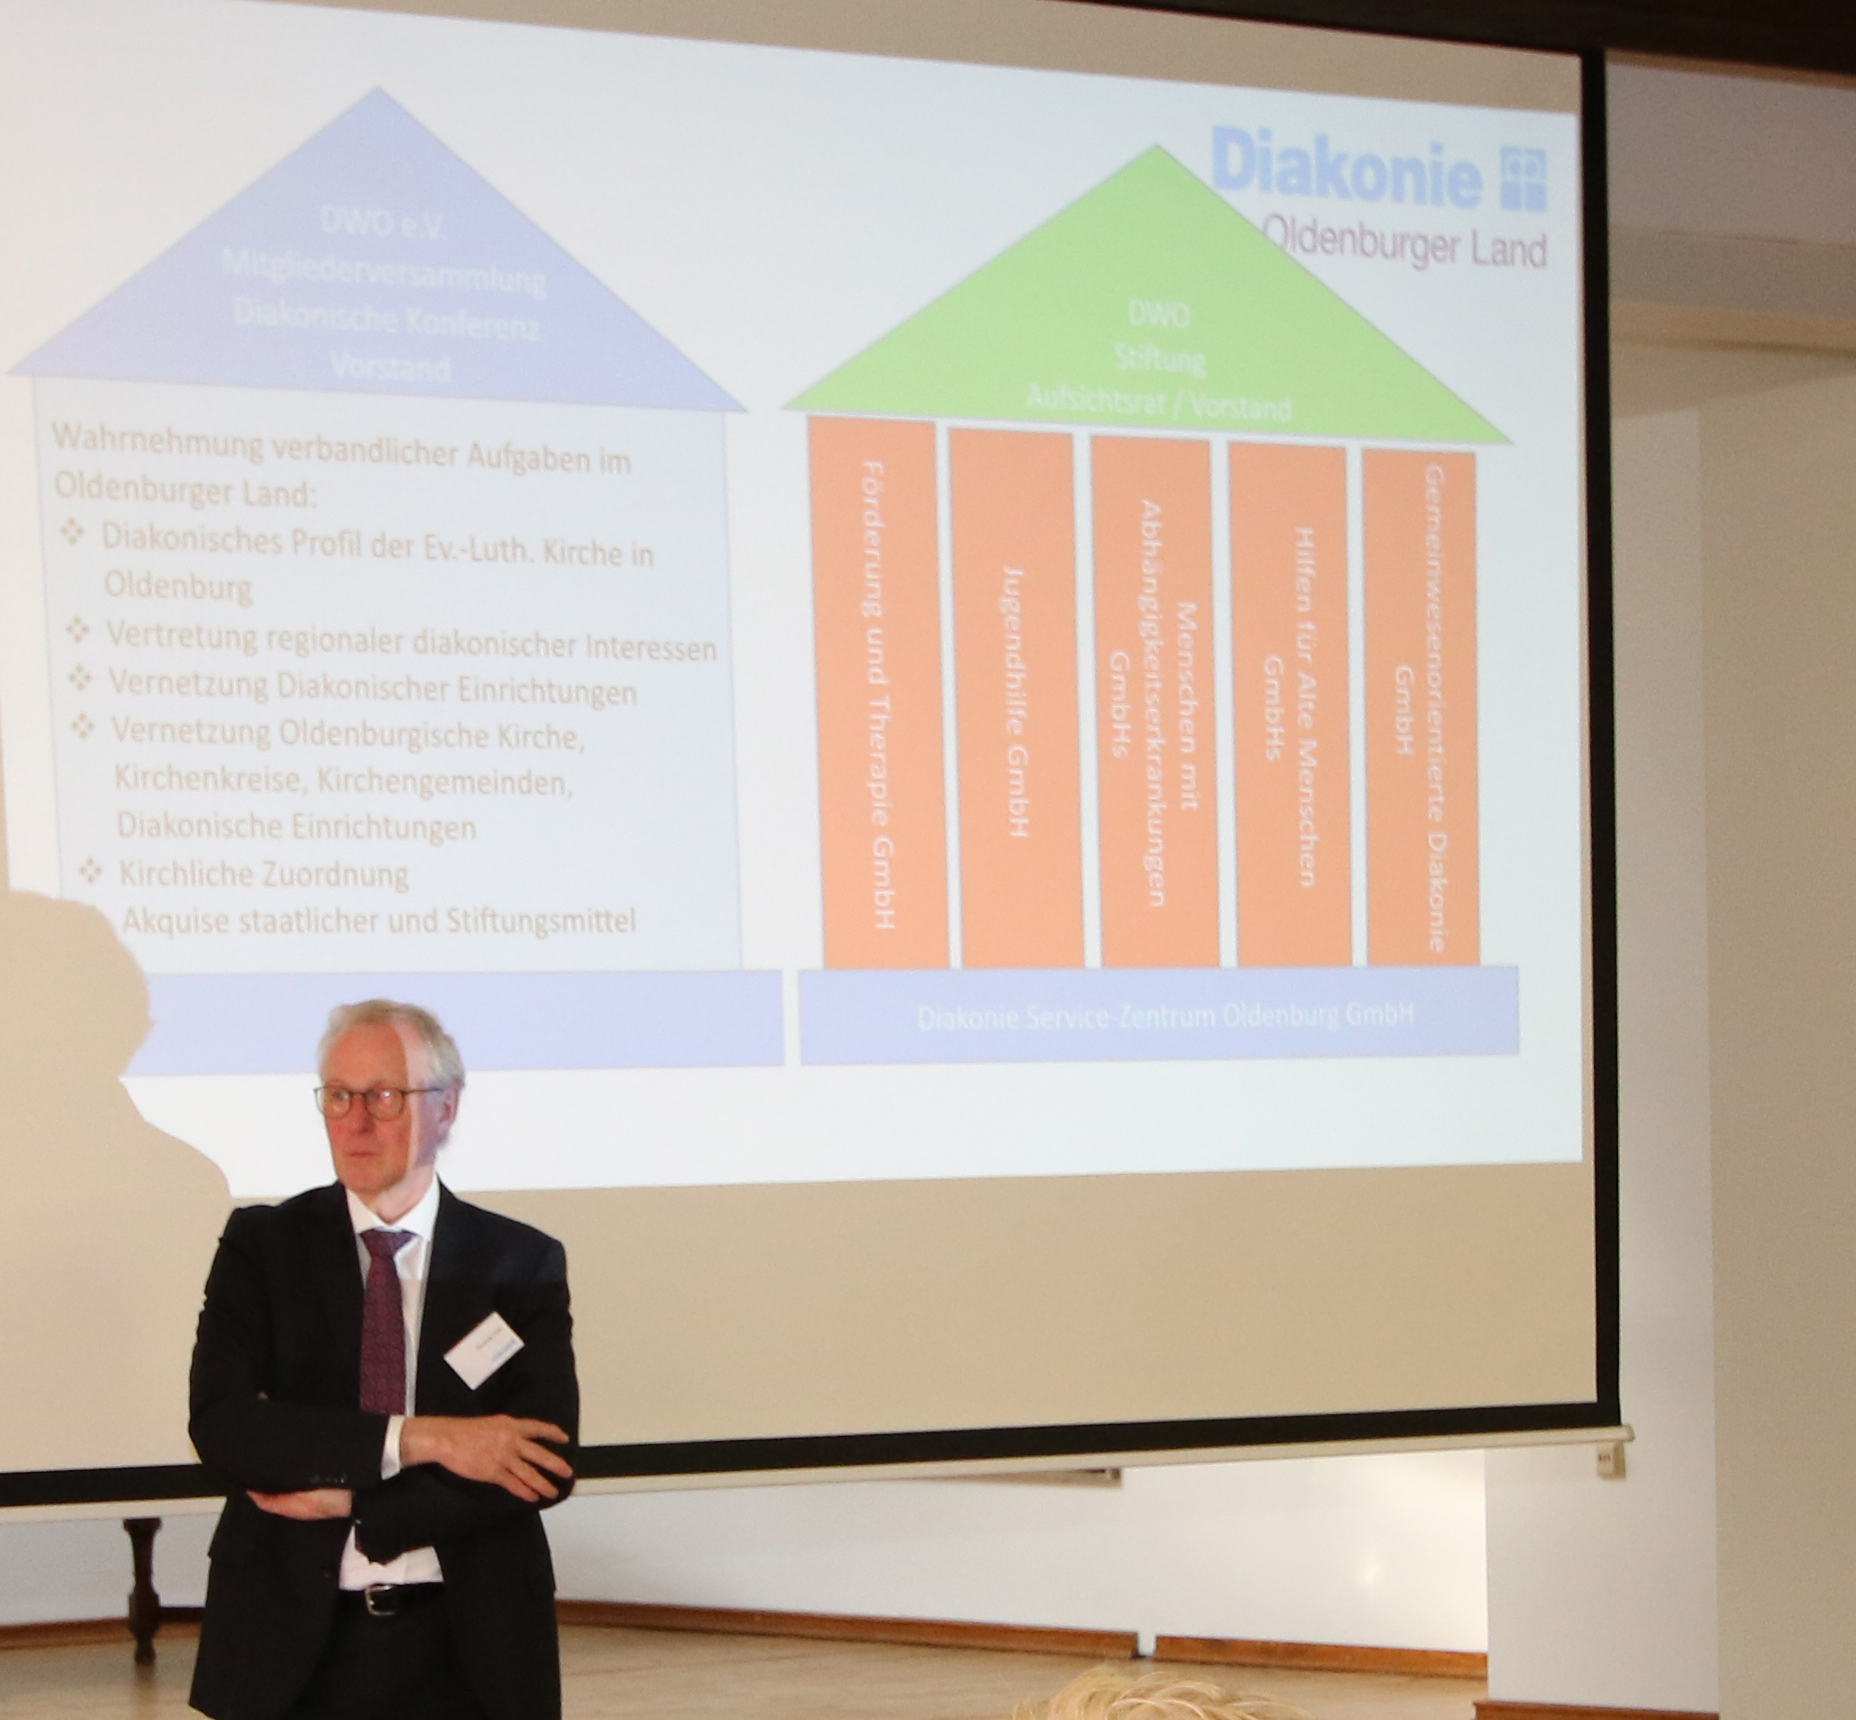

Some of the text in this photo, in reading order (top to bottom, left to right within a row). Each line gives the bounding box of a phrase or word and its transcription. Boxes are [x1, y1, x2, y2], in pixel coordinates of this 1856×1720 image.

[1210, 123, 1483, 211] Diakonie
[320, 203, 448, 241] DWO e.V.
[1471, 228, 1548, 270] Land
[222, 248, 547, 298] Mitgliederversammlung
[232, 295, 541, 343] Diakonische Konferenz
[1128, 297, 1193, 329] DWO
[329, 350, 452, 384] Vorstand
[1113, 341, 1207, 380] Stiftung
[1025, 381, 1167, 414] Aufsichtsrat
[1189, 392, 1294, 422] Vorstand
[50, 421, 631, 477] Wahrnehmung verbandlicher Aufgaben im
[53, 469, 317, 511] Oldenburger Land:
[101, 519, 654, 568] Diakonisches Profil der Ev.-Luth. Kirche in
[103, 568, 254, 609] Oldenburg
[105, 619, 718, 663] Vertretung regionaler diakonischer Interessen
[107, 667, 638, 712] Vernetzung Diakonischer Einrichtungen
[861, 460, 896, 930] Förderung und Therapie GmbH
[999, 565, 1030, 838] Jugendhilfe GmbH
[1109, 649, 1132, 759] GmbHs
[1137, 498, 1168, 908] Abhängigkeitserkrankungen
[1177, 601, 1200, 812] Menschen mit
[1263, 653, 1285, 762] GmbHs
[1295, 526, 1320, 888] Hilfen für Alte Menschen
[1394, 663, 1415, 755] GmbH
[1424, 463, 1449, 954] Gemeinwesenorientierte Diakonie
[110, 715, 585, 754] Vernetzung Oldenburgische Kirche,
[114, 763, 574, 801] Kirchenkreise, Kirchengemeinden,
[116, 809, 477, 848] Diakonische Einrichtungen
[119, 859, 411, 895] Kirchliche Zuordnung
[123, 905, 637, 941] Akquise staatlicher und Stiftungsmittel
[917, 1000, 1415, 1032] Diakonie Service-Zentrum Oldenburg GmbH
